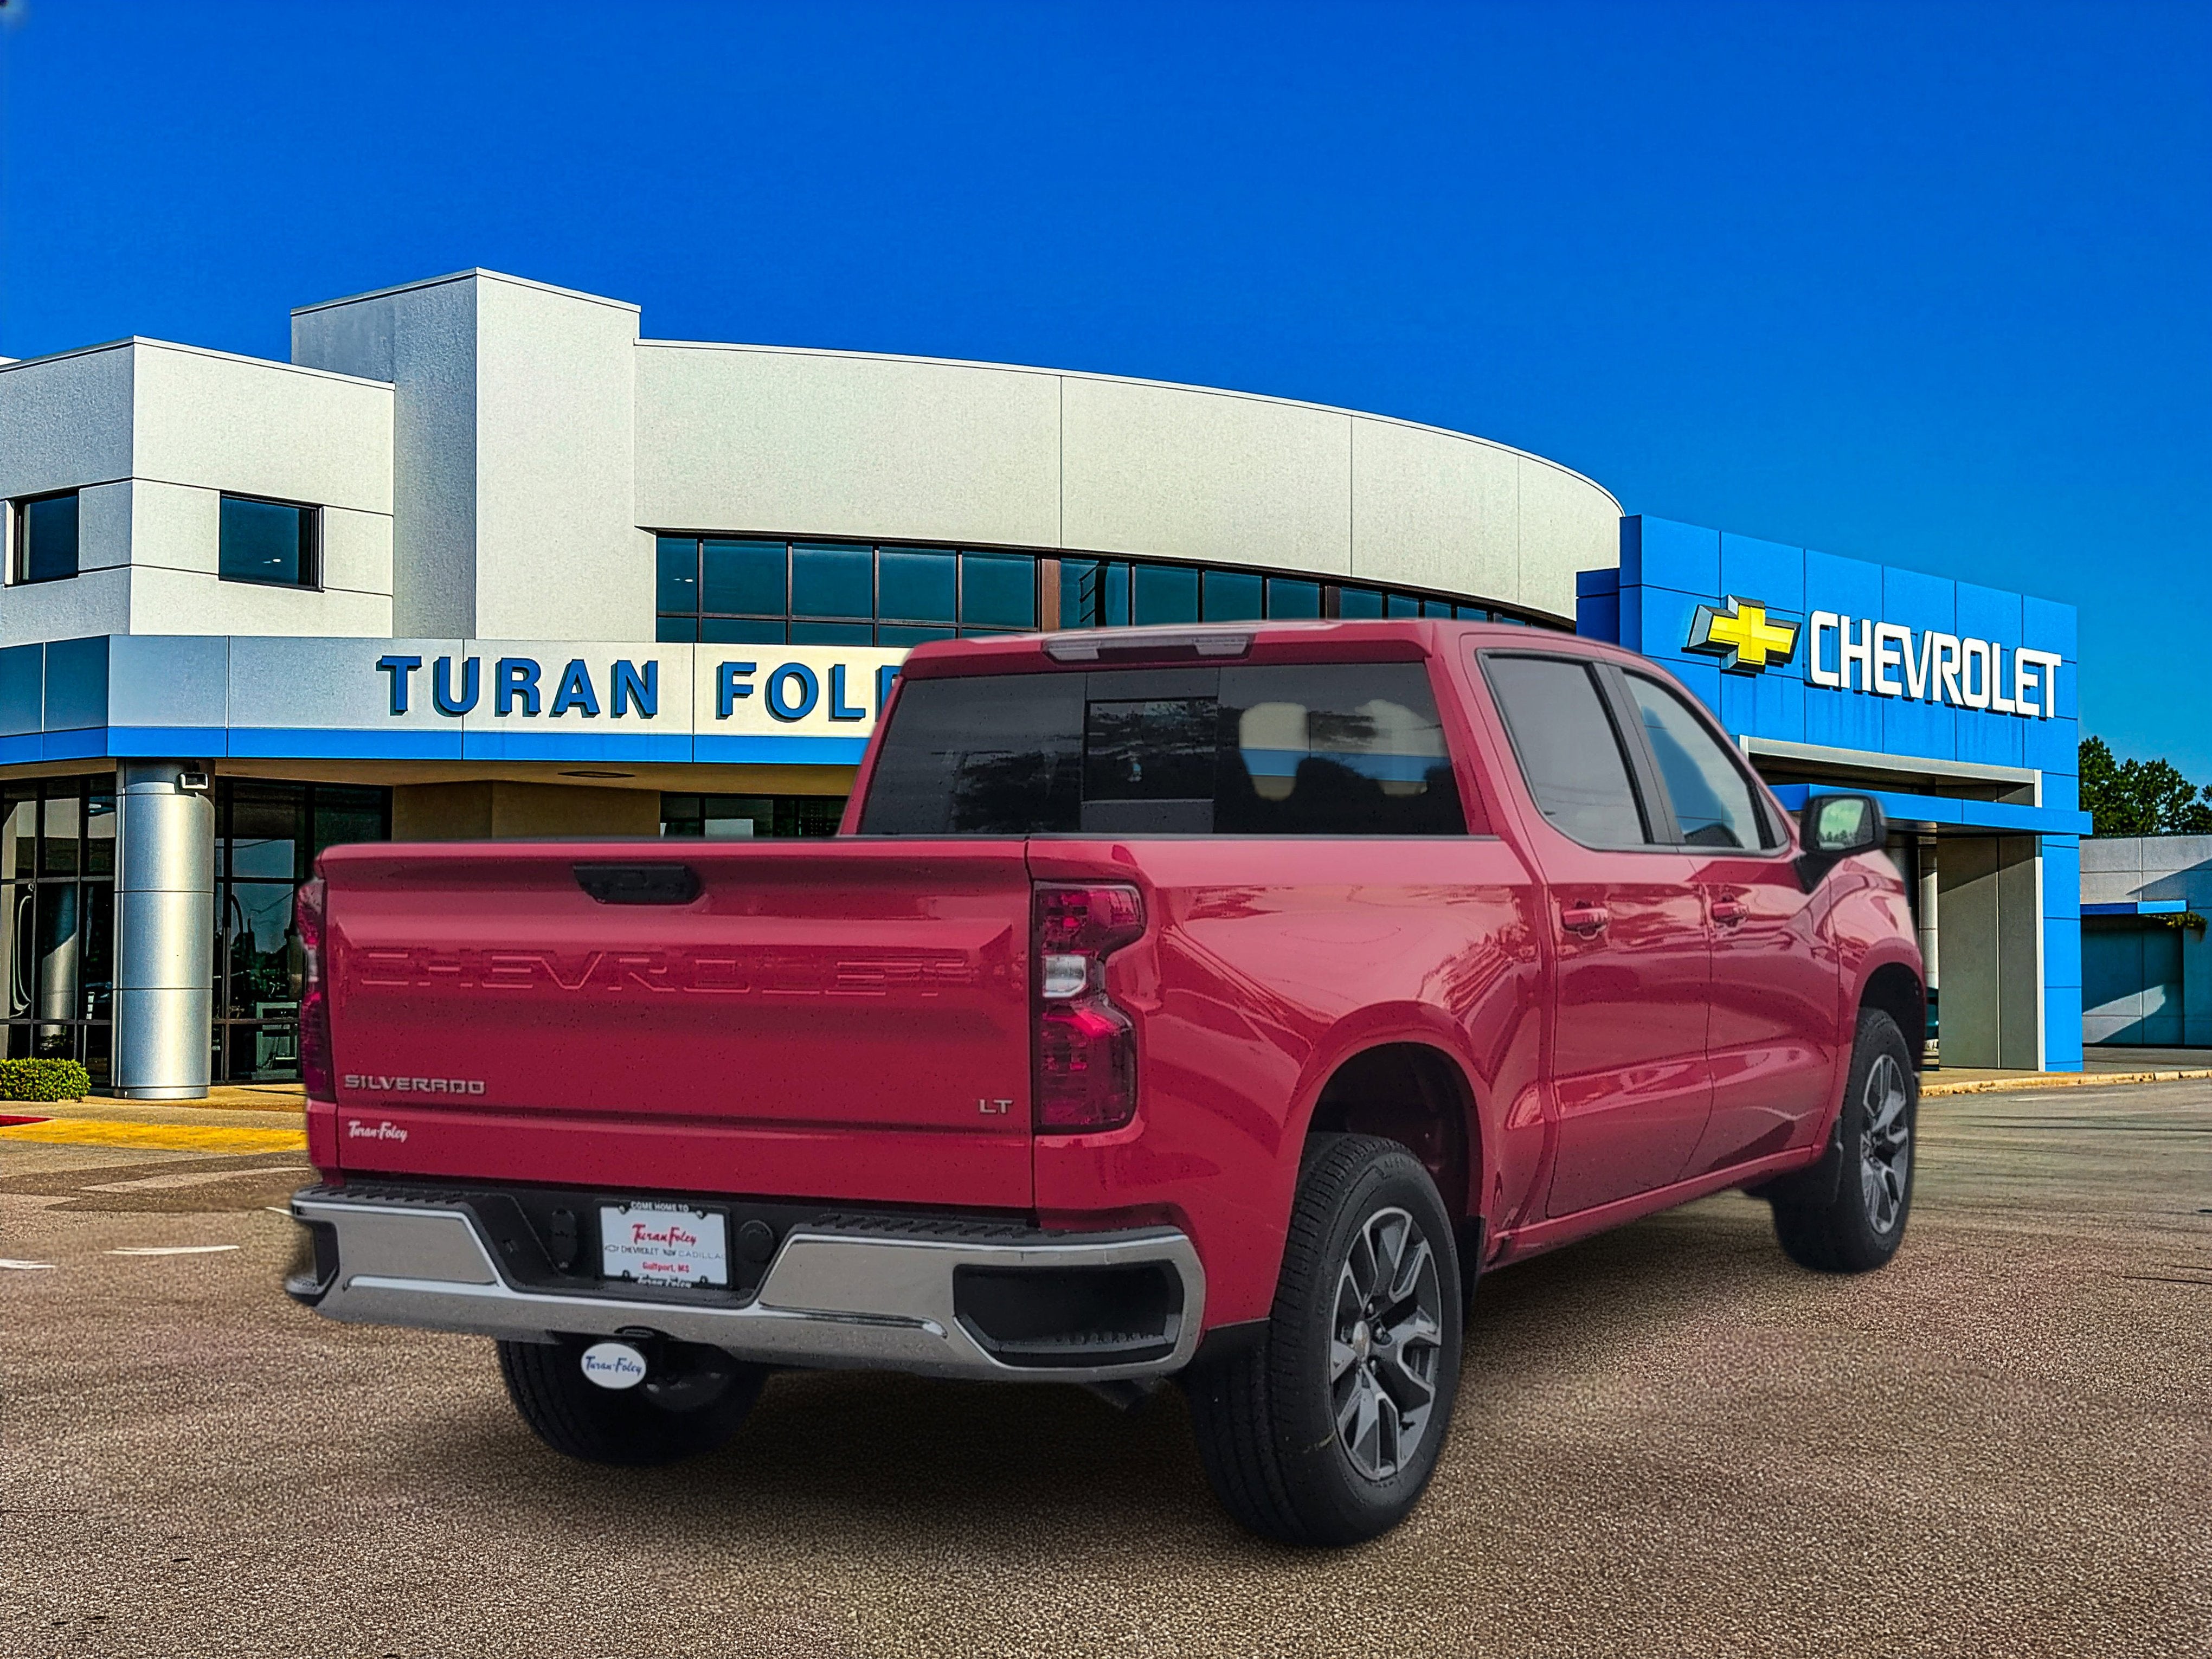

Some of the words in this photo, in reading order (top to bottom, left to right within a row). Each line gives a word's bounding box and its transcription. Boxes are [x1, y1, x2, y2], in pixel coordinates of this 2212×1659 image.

[1810, 610, 2062, 718] CHEVROLET
[376, 655, 658, 719] TURAN
[343, 1074, 486, 1095] SILVERADO
[978, 1098, 1014, 1114] LT
[630, 1200, 653, 1211] COME
[654, 1201, 677, 1212] HOME
